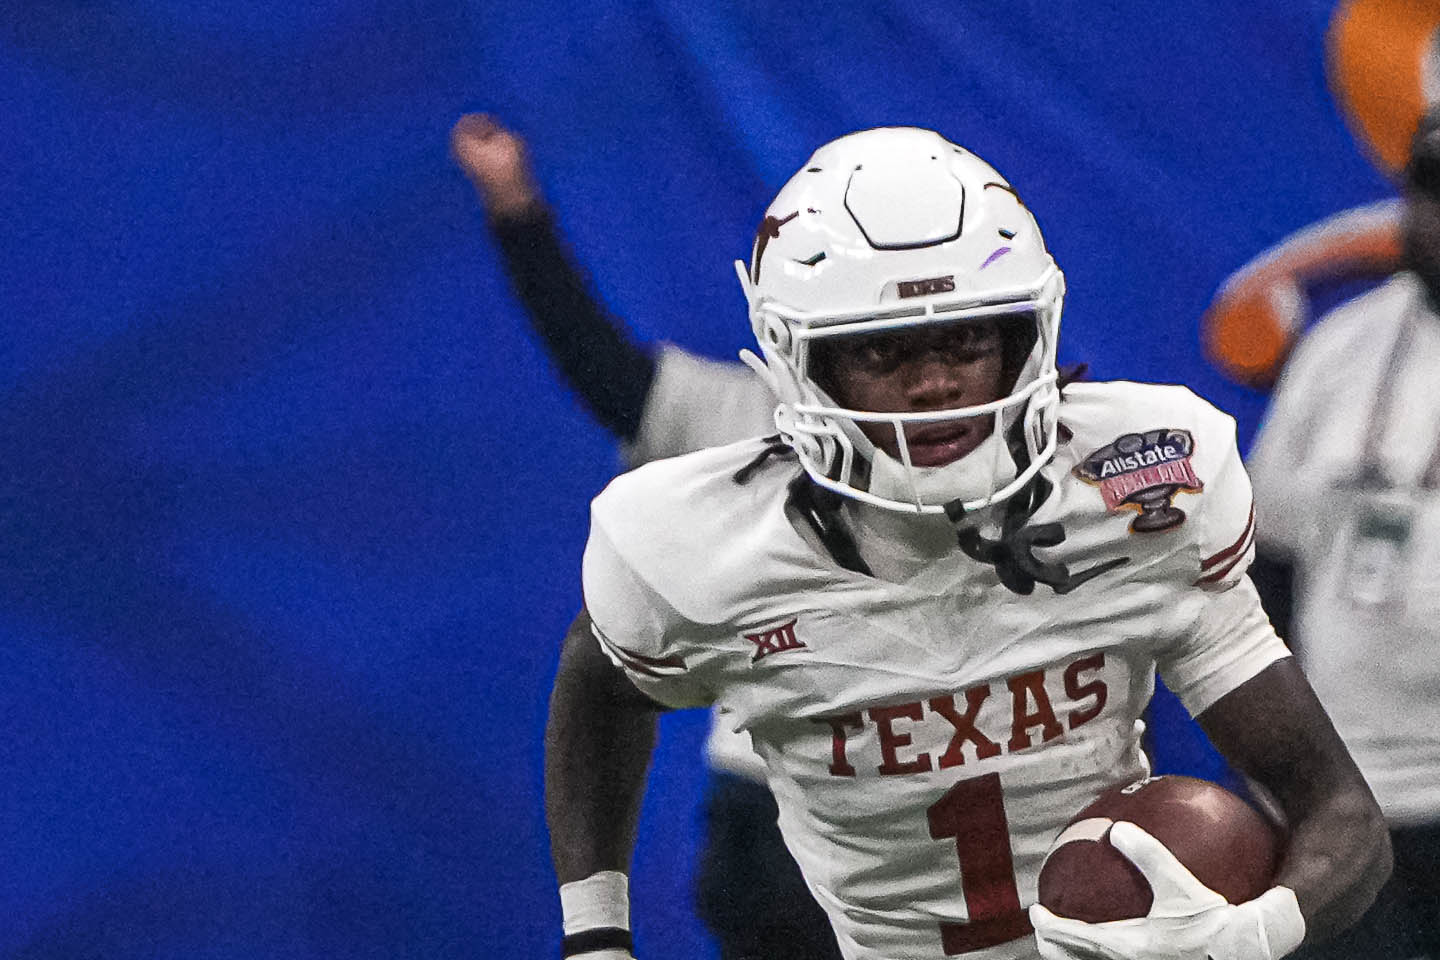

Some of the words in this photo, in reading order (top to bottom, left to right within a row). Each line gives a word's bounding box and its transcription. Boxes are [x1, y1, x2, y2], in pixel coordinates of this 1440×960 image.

[1100, 444, 1177, 478] Allstate
[744, 618, 807, 662] XII
[812, 653, 1108, 777] TEXAS
[926, 771, 1034, 956] 1
